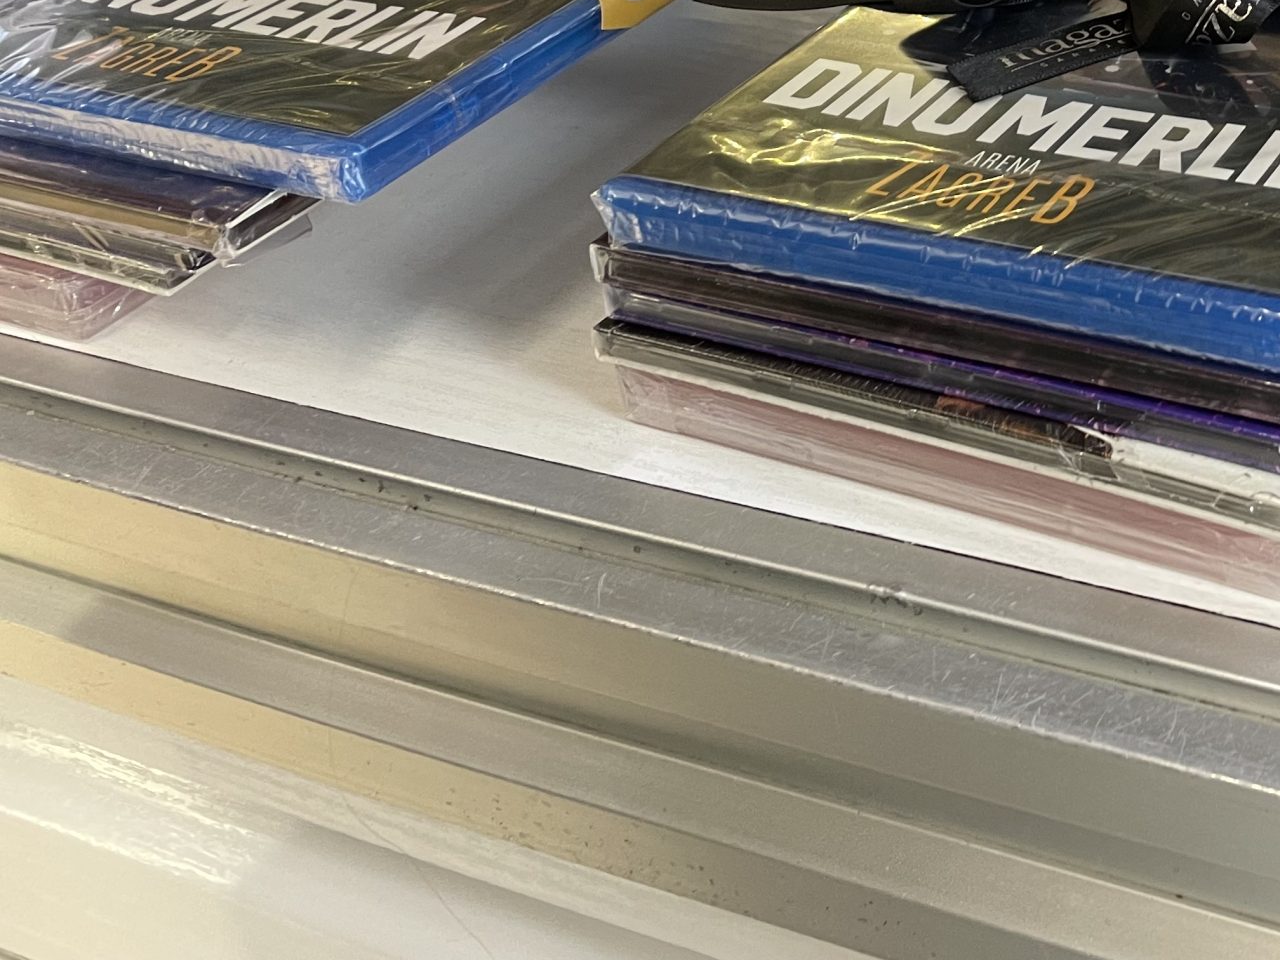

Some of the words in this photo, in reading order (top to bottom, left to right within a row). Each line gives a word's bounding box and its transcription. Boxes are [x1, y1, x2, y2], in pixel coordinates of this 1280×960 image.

[52, 26, 242, 81] ZAGREB
[762, 57, 992, 135] DINO
[866, 150, 1096, 225] ZAGREB
[965, 150, 1042, 176] ARENA
